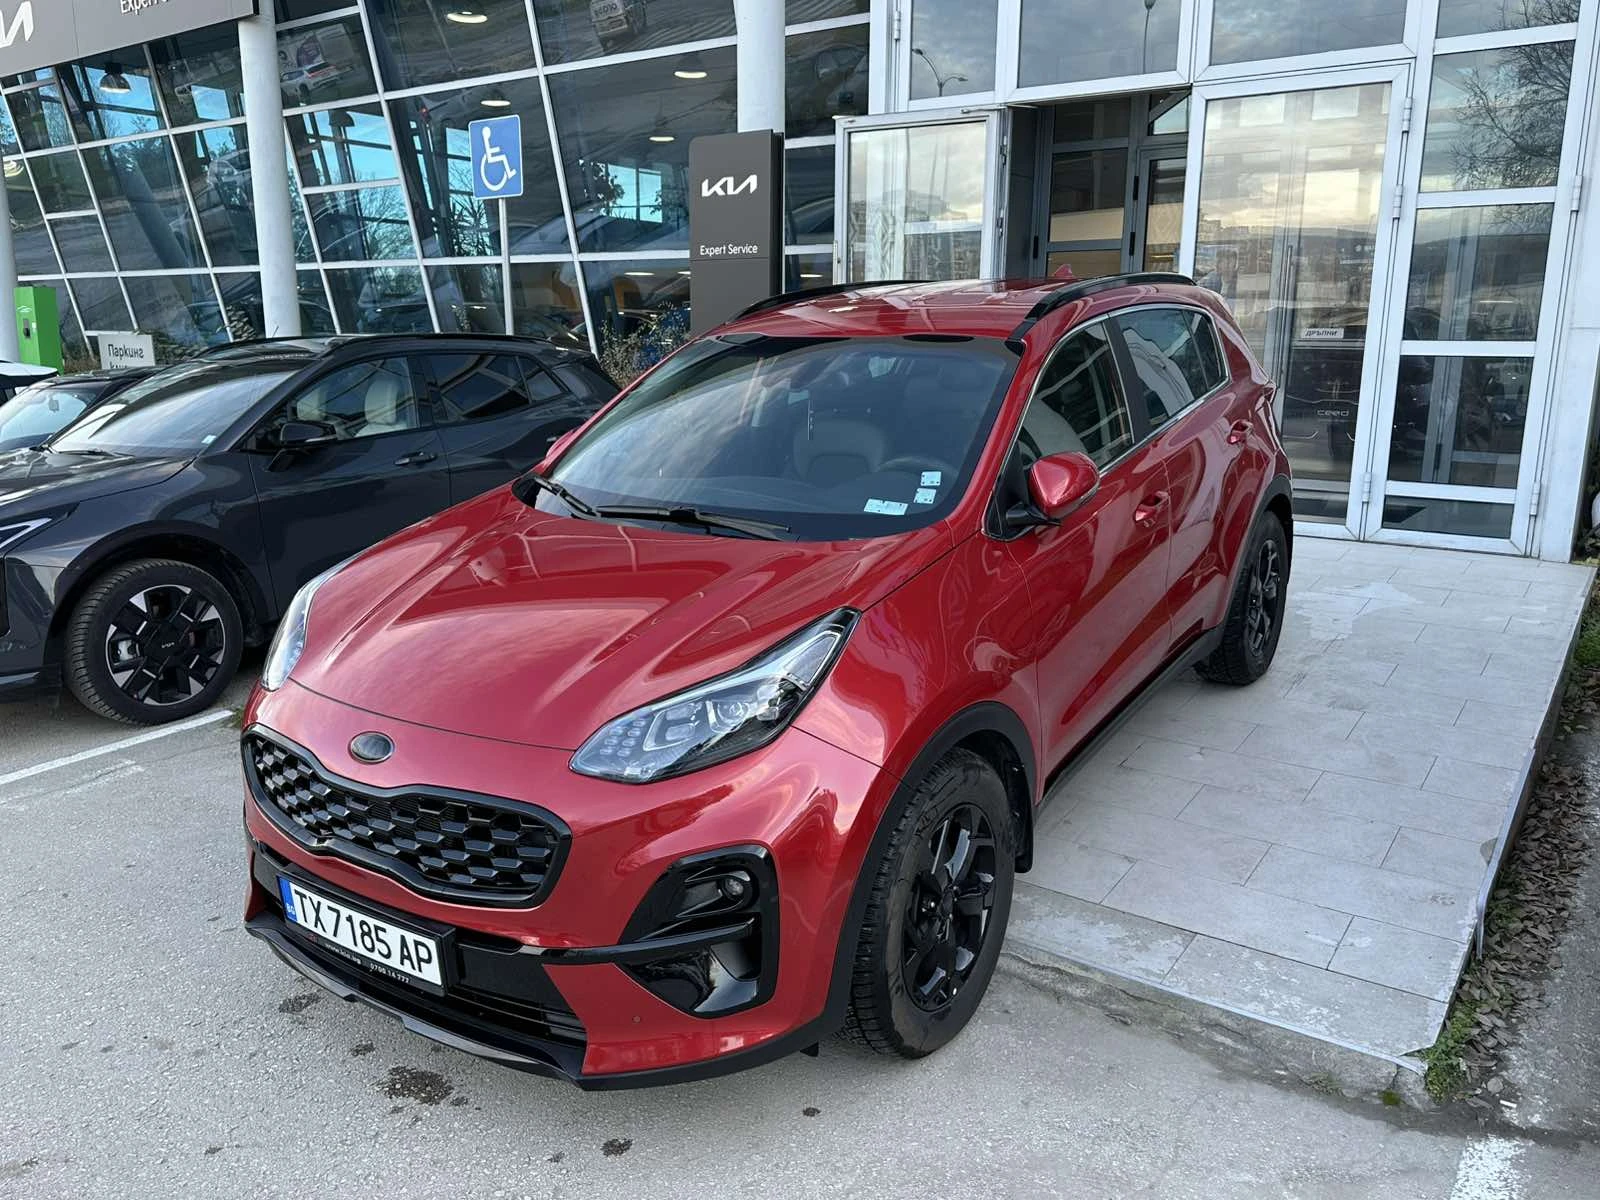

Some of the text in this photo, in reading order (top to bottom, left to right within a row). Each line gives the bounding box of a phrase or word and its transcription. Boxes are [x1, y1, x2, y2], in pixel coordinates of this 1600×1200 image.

[120, 0, 158, 15] Expe
[701, 174, 758, 198] KIA
[700, 243, 758, 257] Expert Service
[107, 343, 145, 360] Паркинг
[294, 889, 433, 973] TX 7185 AP
